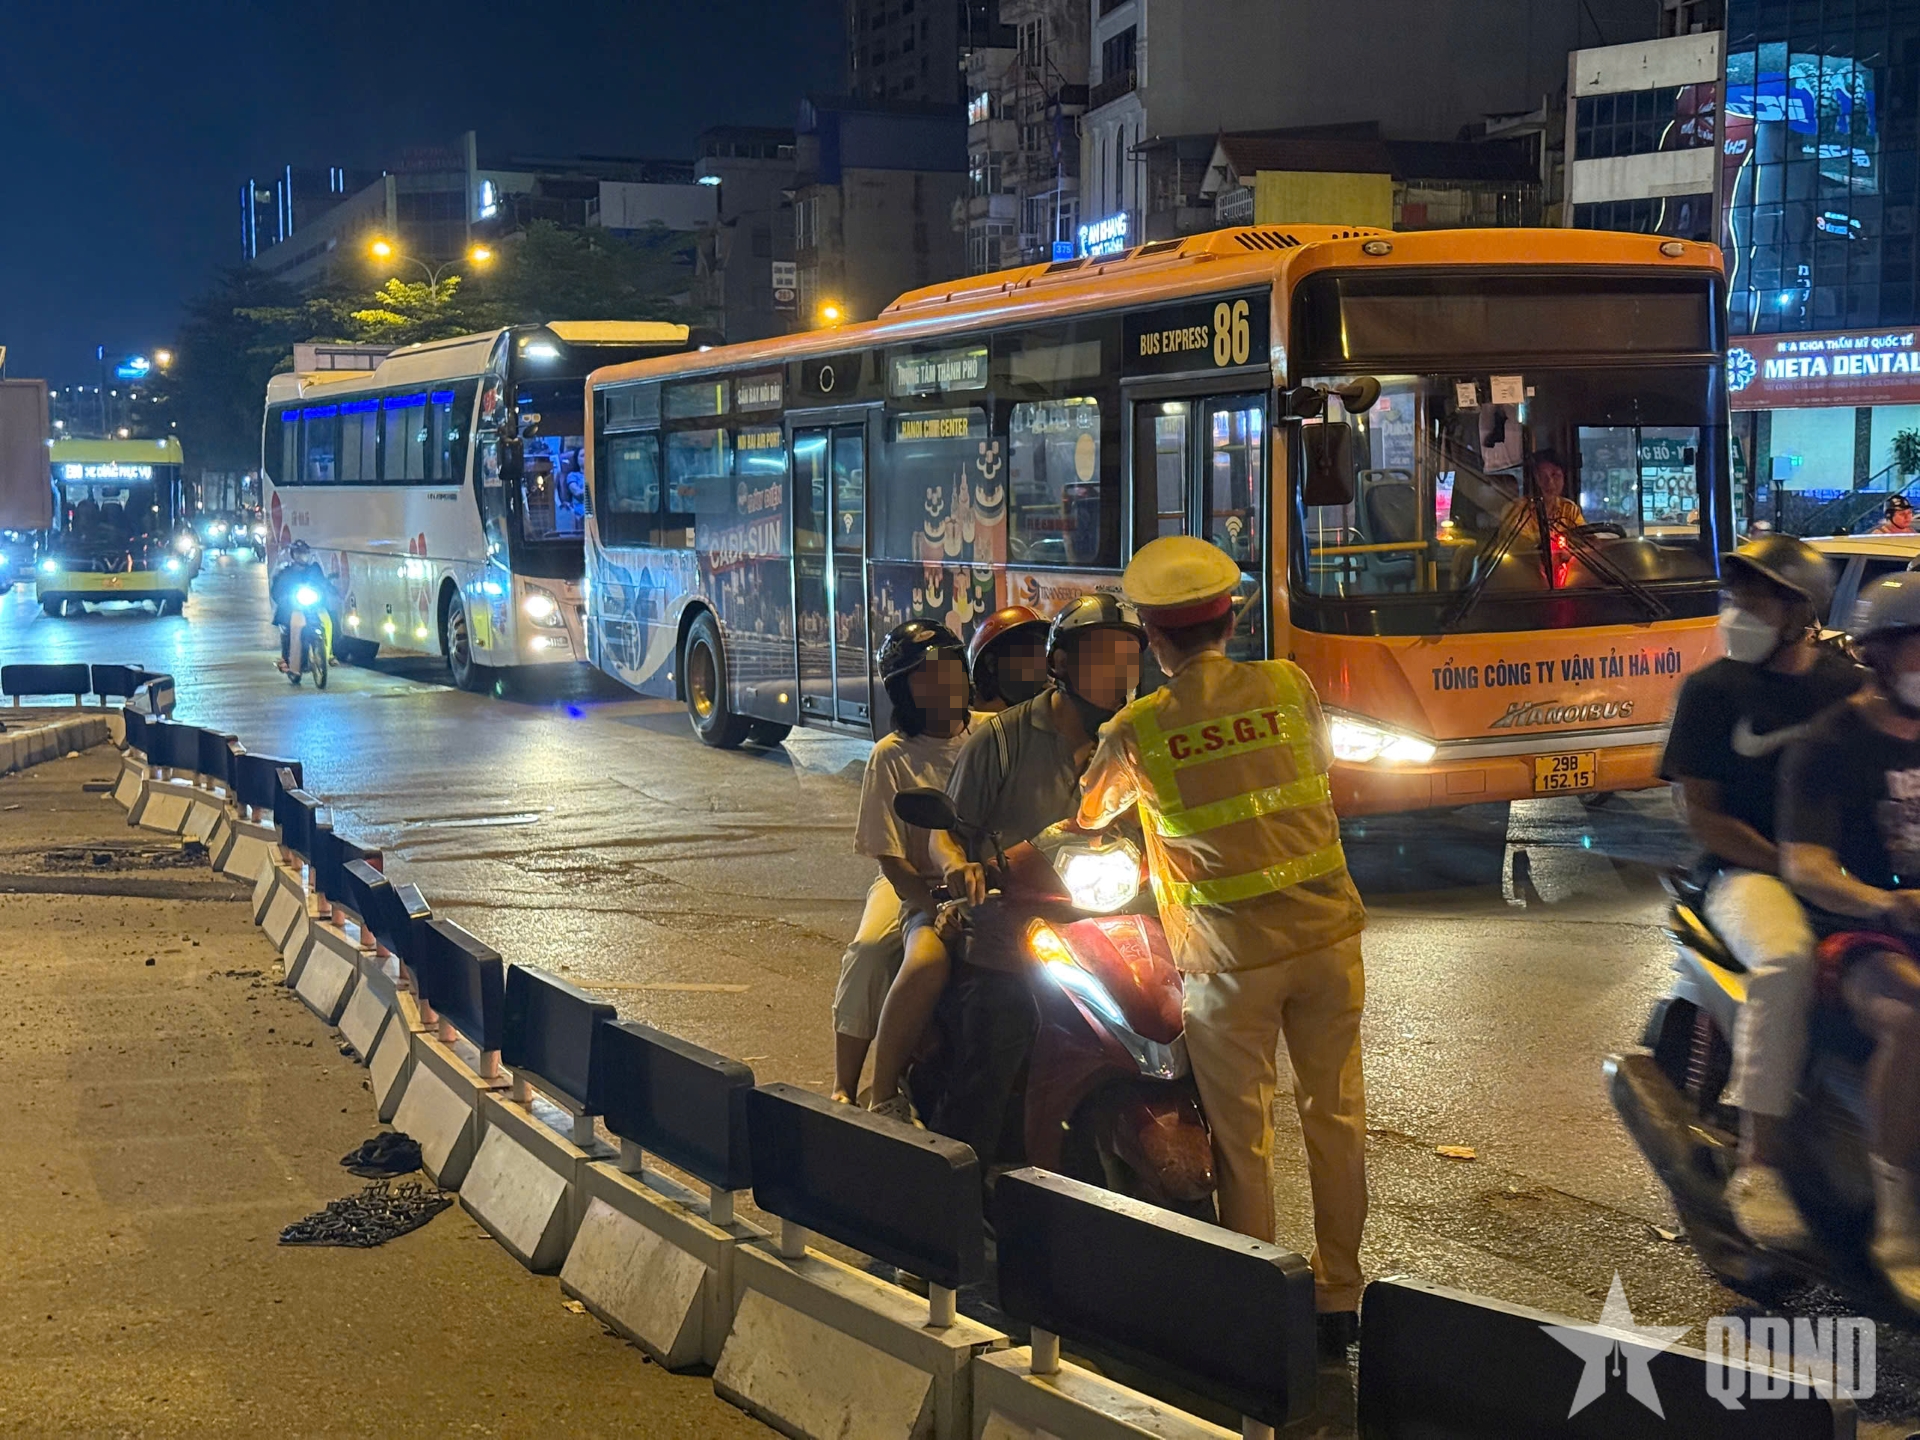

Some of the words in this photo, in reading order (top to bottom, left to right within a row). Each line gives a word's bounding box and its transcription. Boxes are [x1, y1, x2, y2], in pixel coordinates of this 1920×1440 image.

[1088, 223, 1100, 245] AN
[1056, 245, 1072, 253] 375
[1140, 332, 1160, 356] BUS
[1162, 325, 1209, 353] EXPRESS
[1214, 299, 1250, 367] 86
[1799, 340, 1824, 351] KHOA
[1871, 334, 1899, 350] QUỐC
[921, 361, 935, 384] TÂM
[1764, 356, 1829, 378] META
[1833, 351, 1920, 375] DENTAL
[902, 421, 922, 438] HANOI
[940, 418, 968, 437] CENTER
[1432, 657, 1478, 691] TỔNG
[1484, 659, 1531, 687] CÔNG
[1536, 661, 1555, 683] TY
[1561, 654, 1594, 686] VẬN
[1600, 647, 1623, 678] TẢI
[1629, 648, 1650, 676] HÀ
[1655, 647, 1681, 679] NỘI
[1168, 710, 1280, 760] C.S.G.T
[1552, 756, 1578, 772] 29B
[1543, 771, 1589, 789] 152.15
